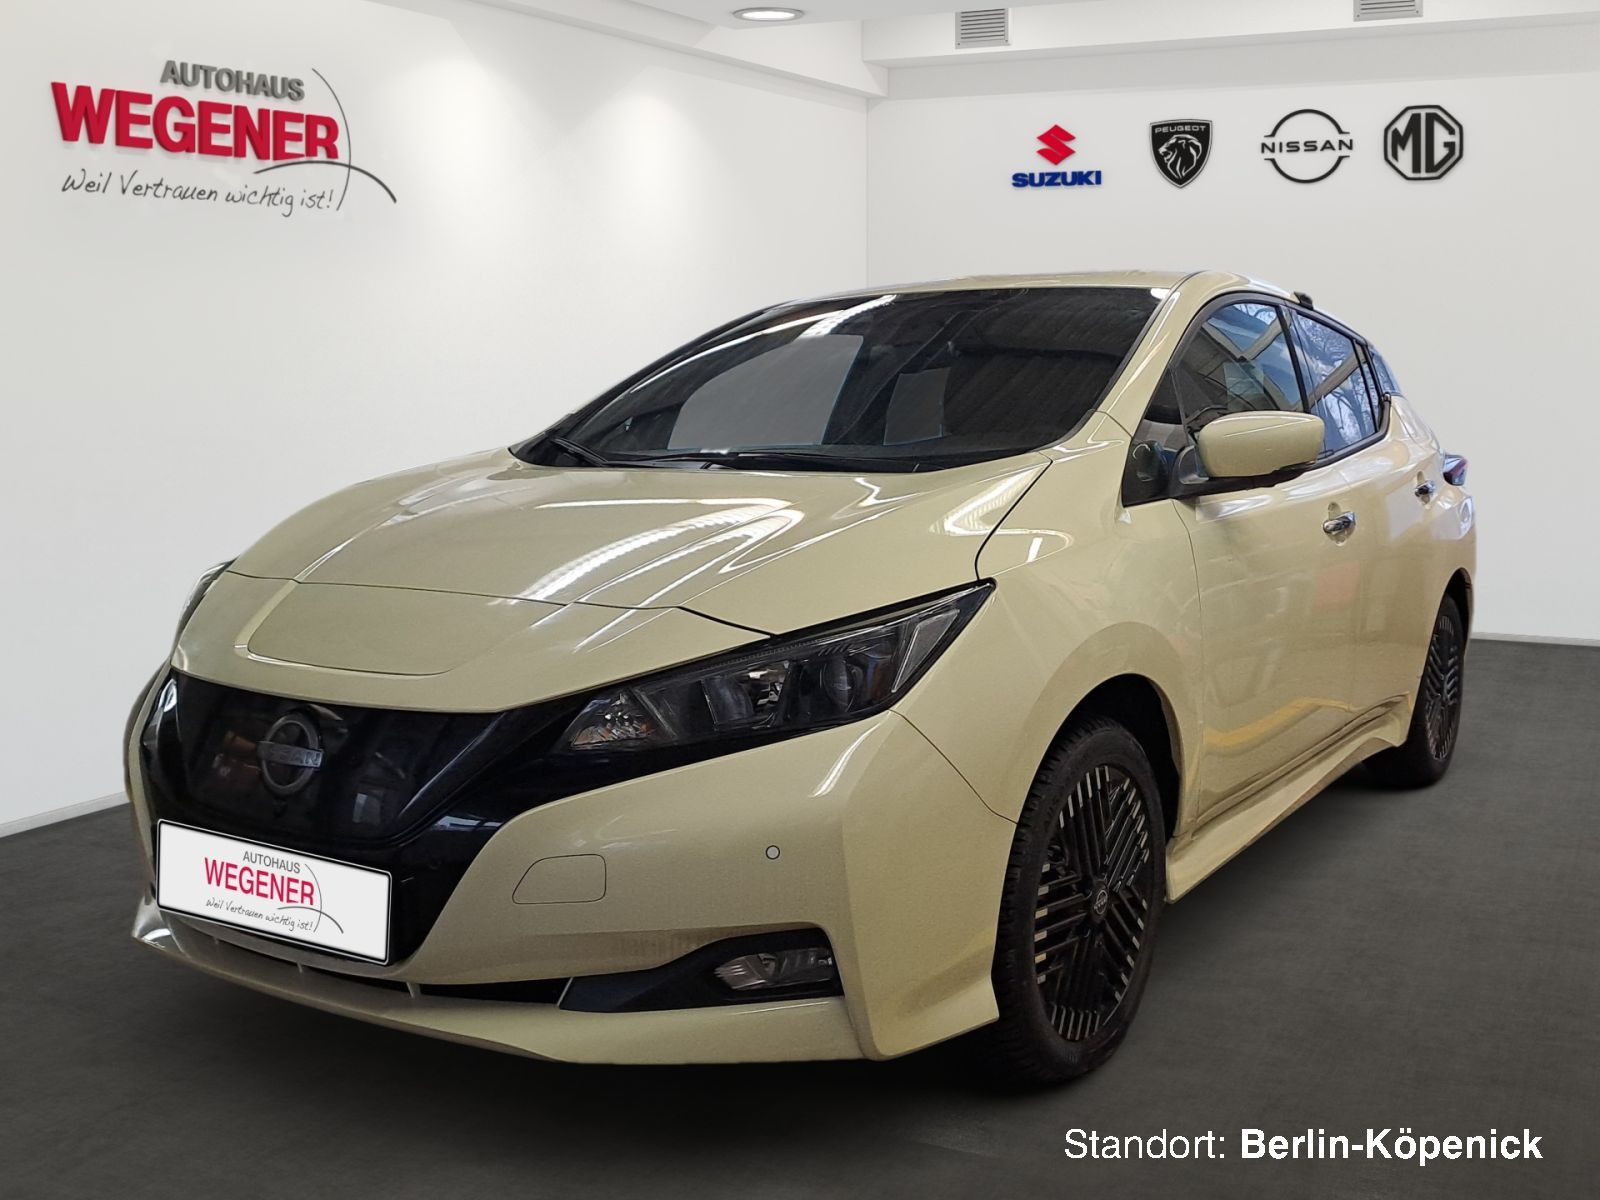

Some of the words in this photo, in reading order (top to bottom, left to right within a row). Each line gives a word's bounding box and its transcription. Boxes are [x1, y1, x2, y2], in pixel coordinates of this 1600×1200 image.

[160, 60, 305, 101] AUTOHAUS
[51, 81, 339, 161] WEGENER
[1154, 125, 1207, 133] PEUGEOT
[1261, 139, 1353, 154] NISSAN
[1391, 112, 1456, 174] MG
[62, 168, 112, 194] Weil
[119, 170, 219, 202] Vertrauen
[225, 188, 294, 217] wichtig
[300, 189, 333, 210] ist!
[1011, 170, 1102, 188] SUZUKI
[243, 851, 300, 873] AUTOHAUS
[204, 858, 315, 905] WEGENER
[206, 897, 223, 909] Weil
[226, 902, 263, 919] Vertrauen
[265, 914, 295, 931] wichtig
[296, 919, 313, 932] ist!
